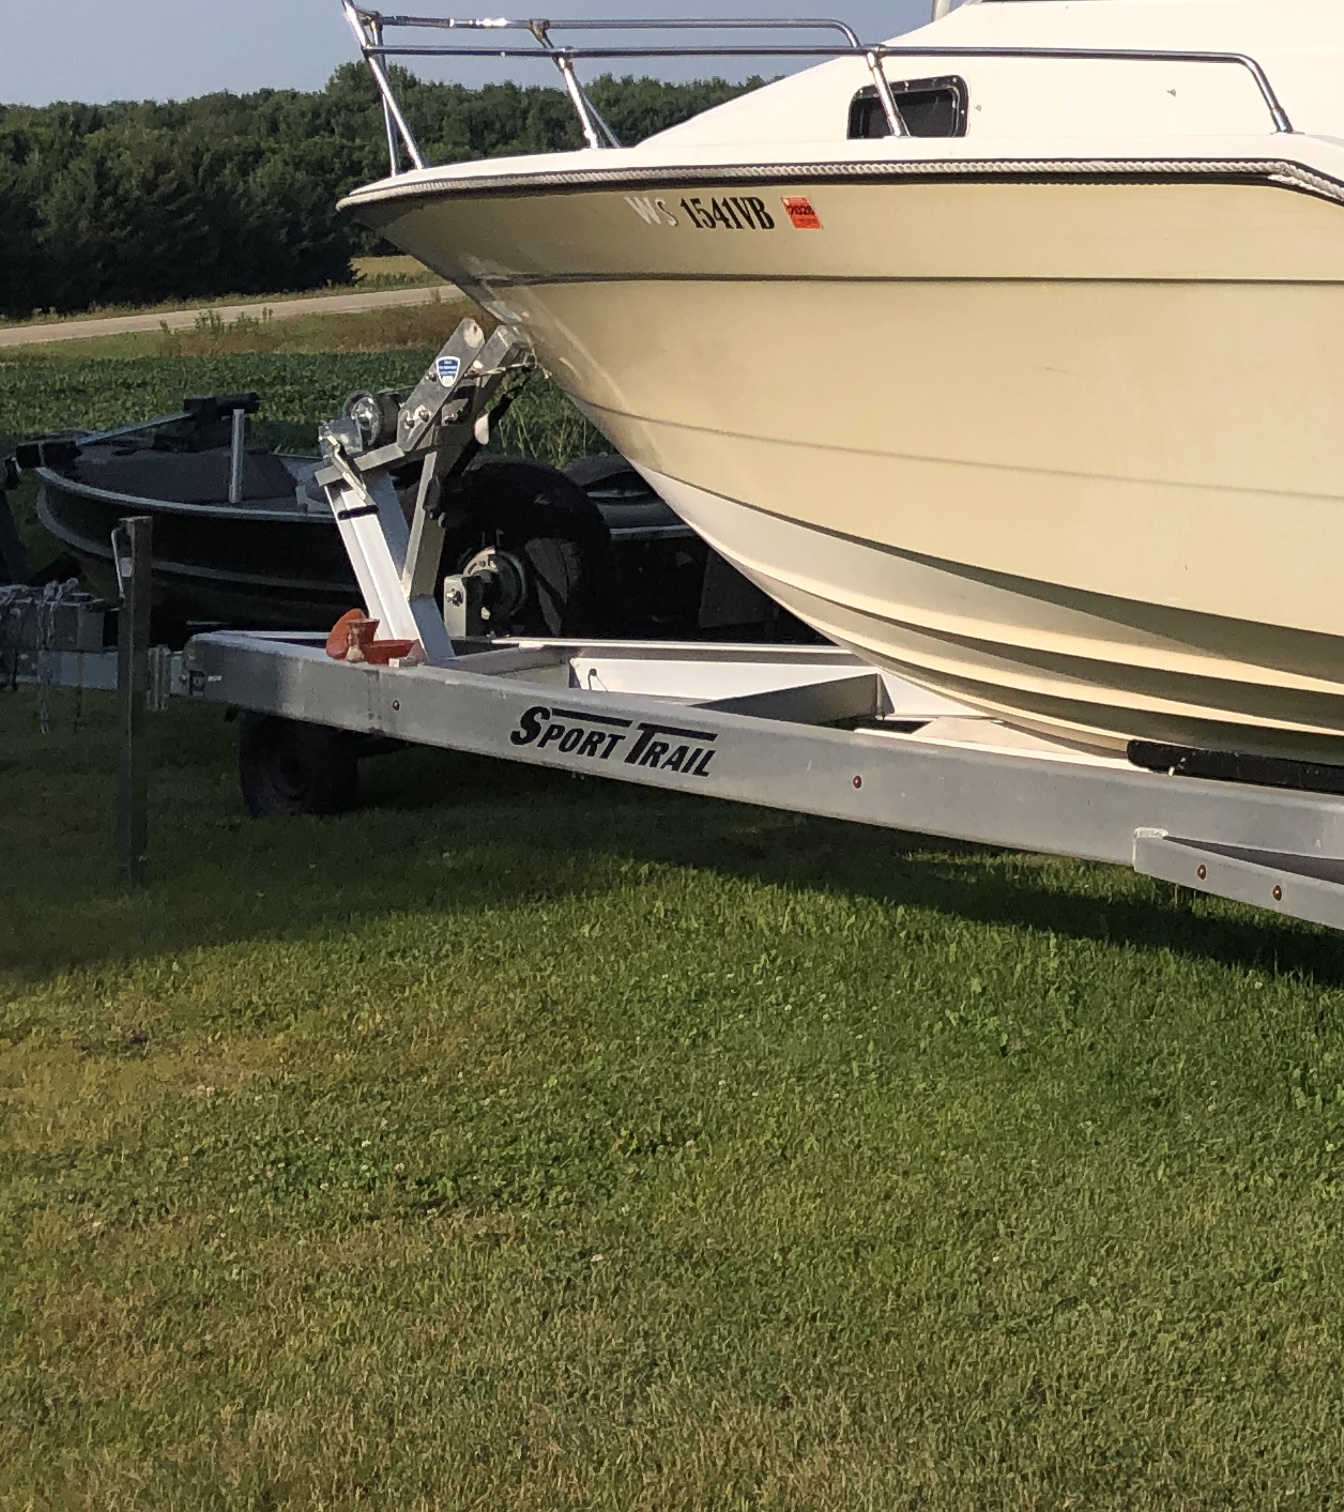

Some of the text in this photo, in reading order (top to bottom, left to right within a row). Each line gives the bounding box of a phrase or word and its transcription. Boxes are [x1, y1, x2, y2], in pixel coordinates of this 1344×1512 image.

[624, 195, 776, 230] WS 1541VB
[510, 705, 719, 778] SPORT TRAIL
